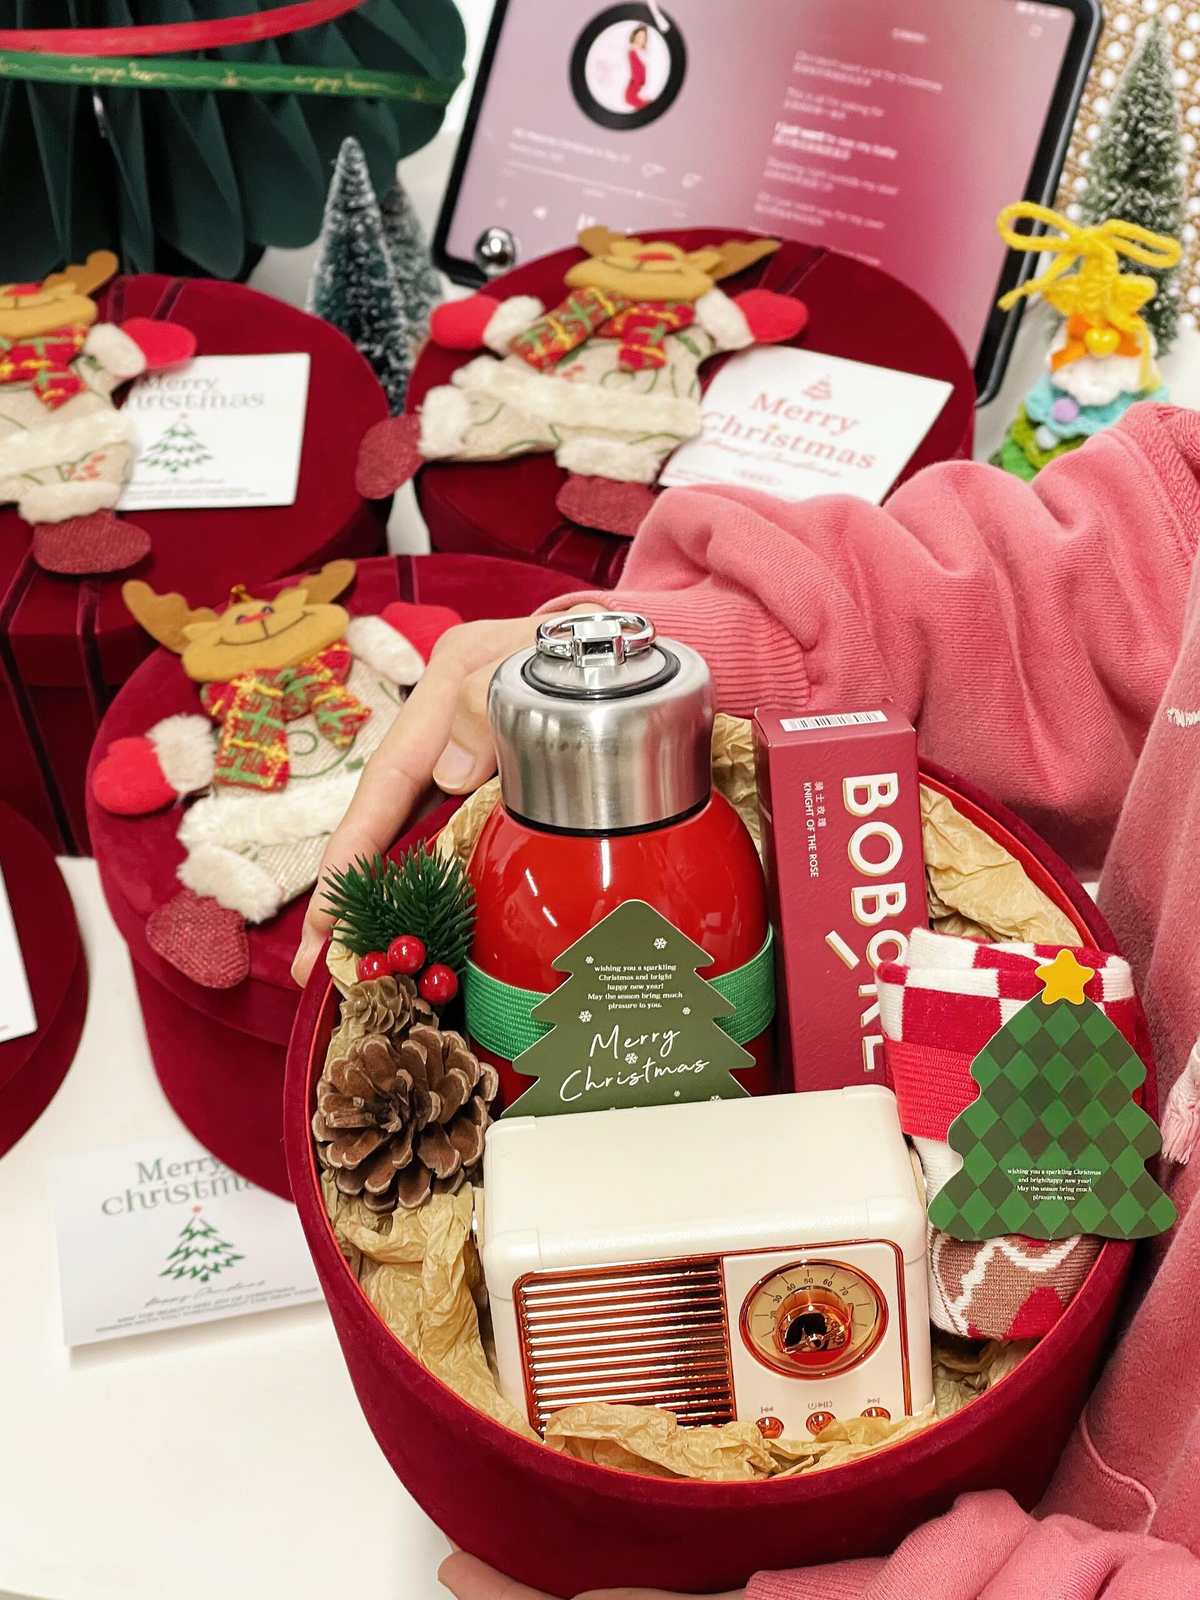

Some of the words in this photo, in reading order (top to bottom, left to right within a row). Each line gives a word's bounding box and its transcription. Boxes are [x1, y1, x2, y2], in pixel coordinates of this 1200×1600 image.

[751, 391, 861, 437] Merry
[702, 410, 877, 470] Christmas
[803, 782, 815, 817] KNIGHT
[806, 819, 815, 833] OF
[807, 833, 817, 852] THE
[809, 853, 819, 878] ROSE
[643, 964, 677, 972] sparkling
[650, 973, 672, 981] bright
[587, 993, 603, 1001] May
[641, 992, 661, 1000] bring
[646, 983, 664, 991] year!
[589, 1024, 681, 1060] Merry
[559, 1056, 710, 1102] Christmas
[136, 1155, 227, 1185] Merry
[100, 1171, 253, 1216] christm
[773, 1295, 782, 1303] 30
[786, 1284, 796, 1292] 40
[822, 1279, 833, 1287] 60
[840, 1287, 849, 1296] 70
